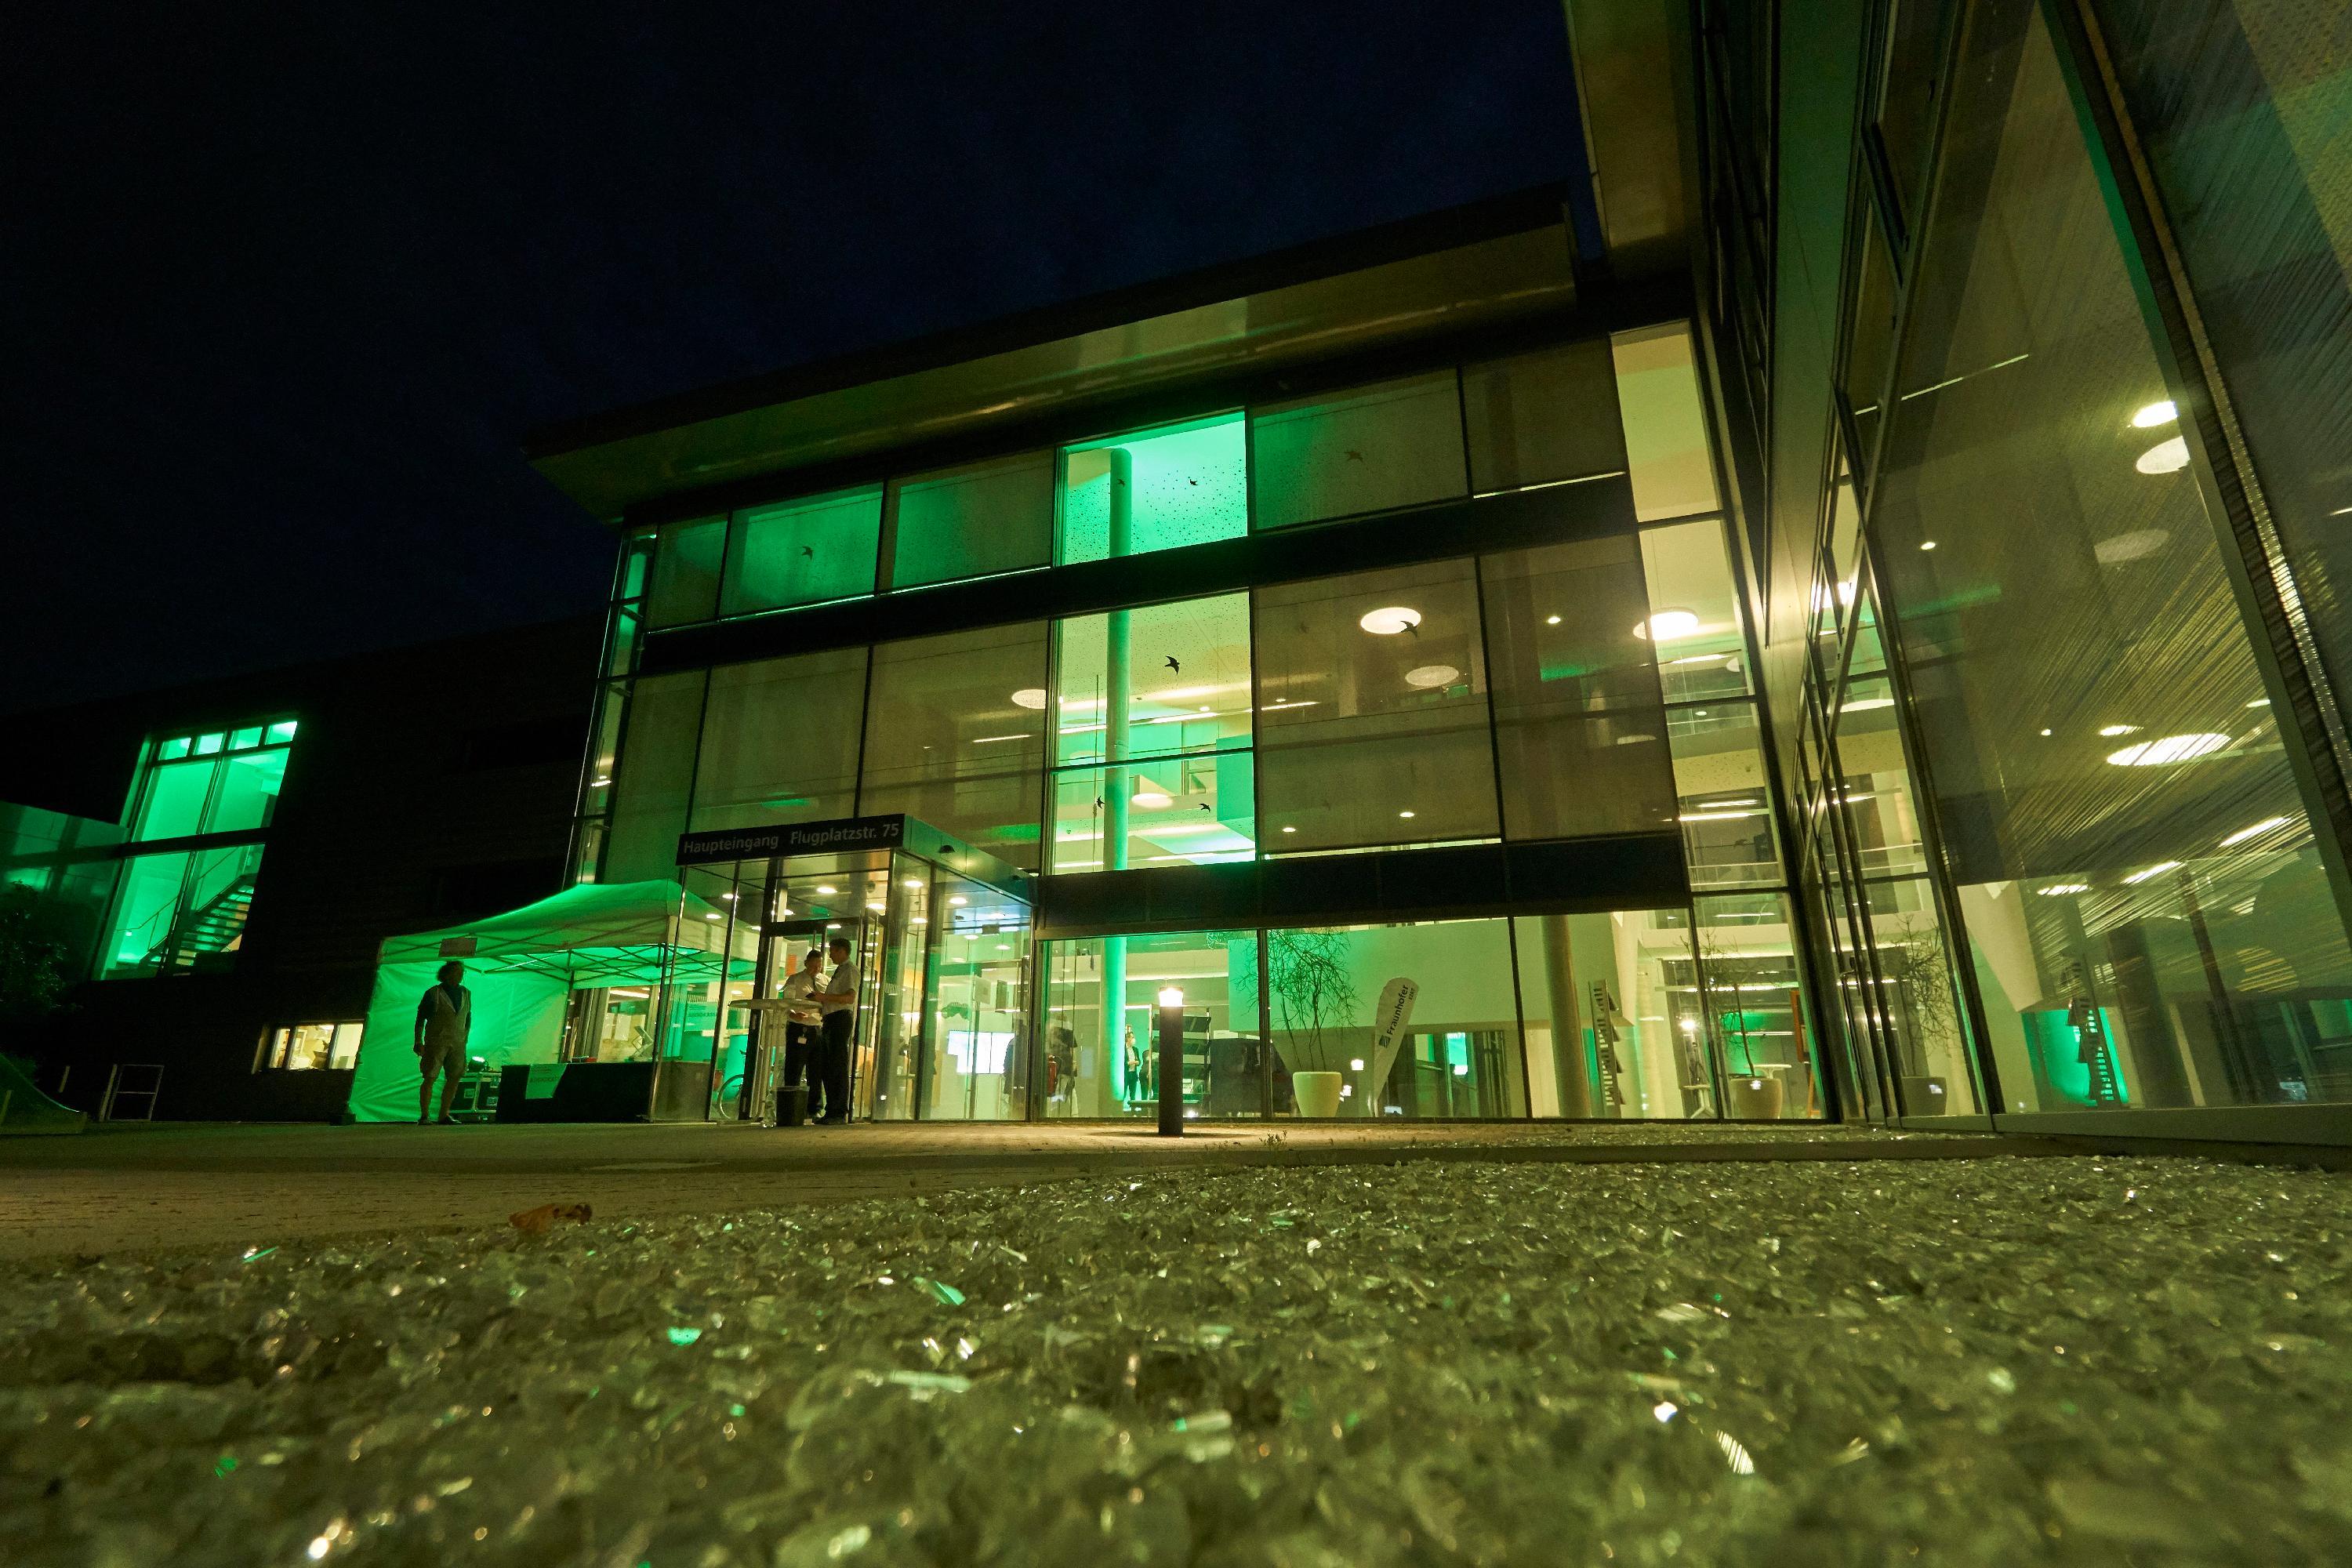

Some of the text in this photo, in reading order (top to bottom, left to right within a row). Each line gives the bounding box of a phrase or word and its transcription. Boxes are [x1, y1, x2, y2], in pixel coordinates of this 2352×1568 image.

[684, 823, 899, 853] Haupteingang Flugplatzstr. 75
[1387, 984, 1409, 1035] Fraunhofer
